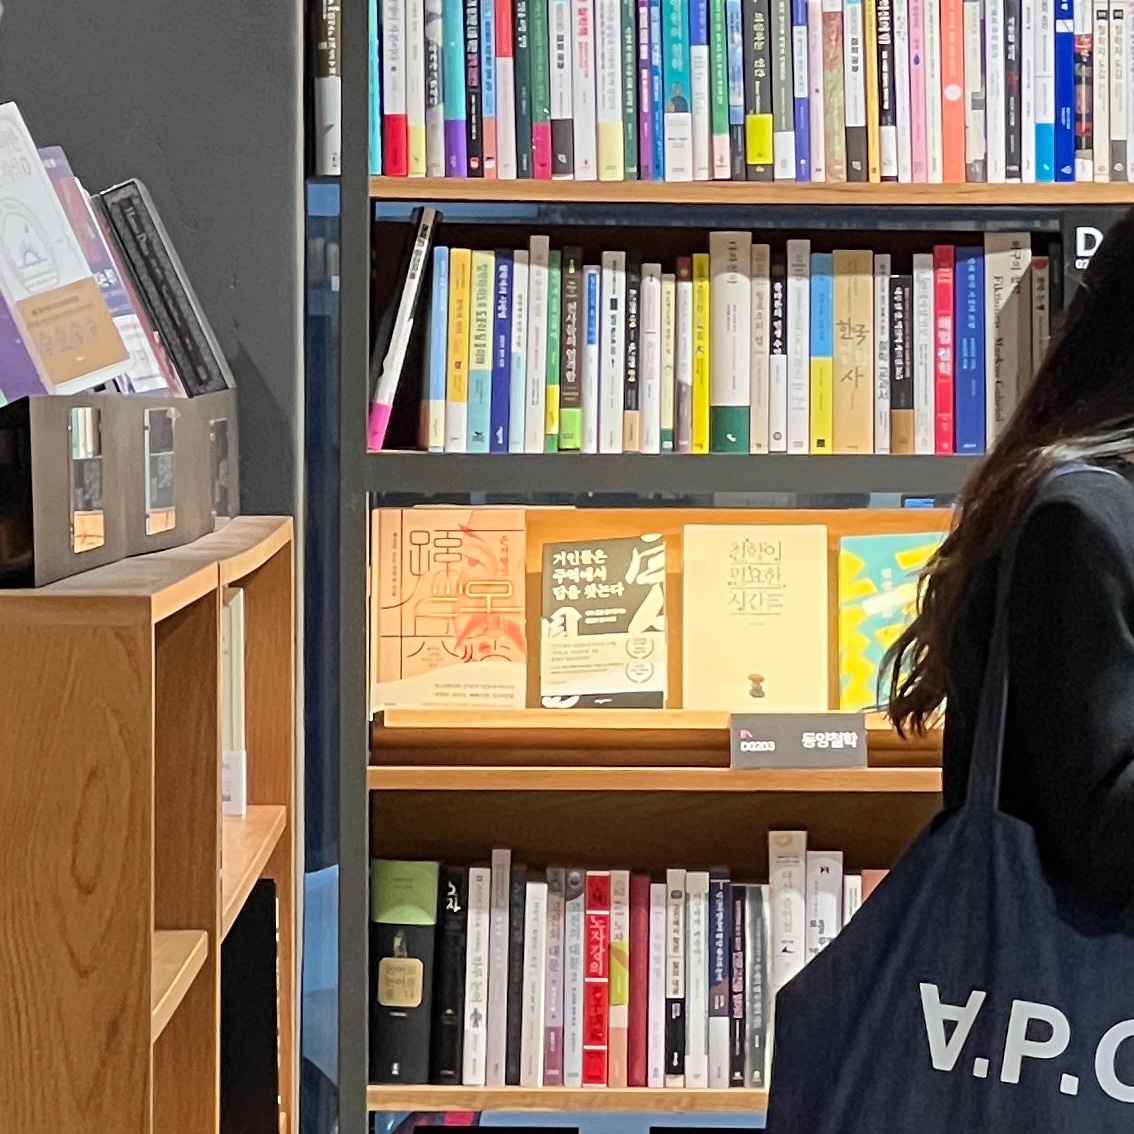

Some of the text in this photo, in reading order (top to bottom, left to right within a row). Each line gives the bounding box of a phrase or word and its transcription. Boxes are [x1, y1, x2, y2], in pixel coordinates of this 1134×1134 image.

[1076, 227, 1104, 257] D
[994, 337, 1006, 380] Markus
[552, 548, 608, 566] 거인들은
[552, 566, 608, 584] 주역에서
[552, 580, 625, 601] 답을 찾는다
[802, 732, 858, 749] 동양철학
